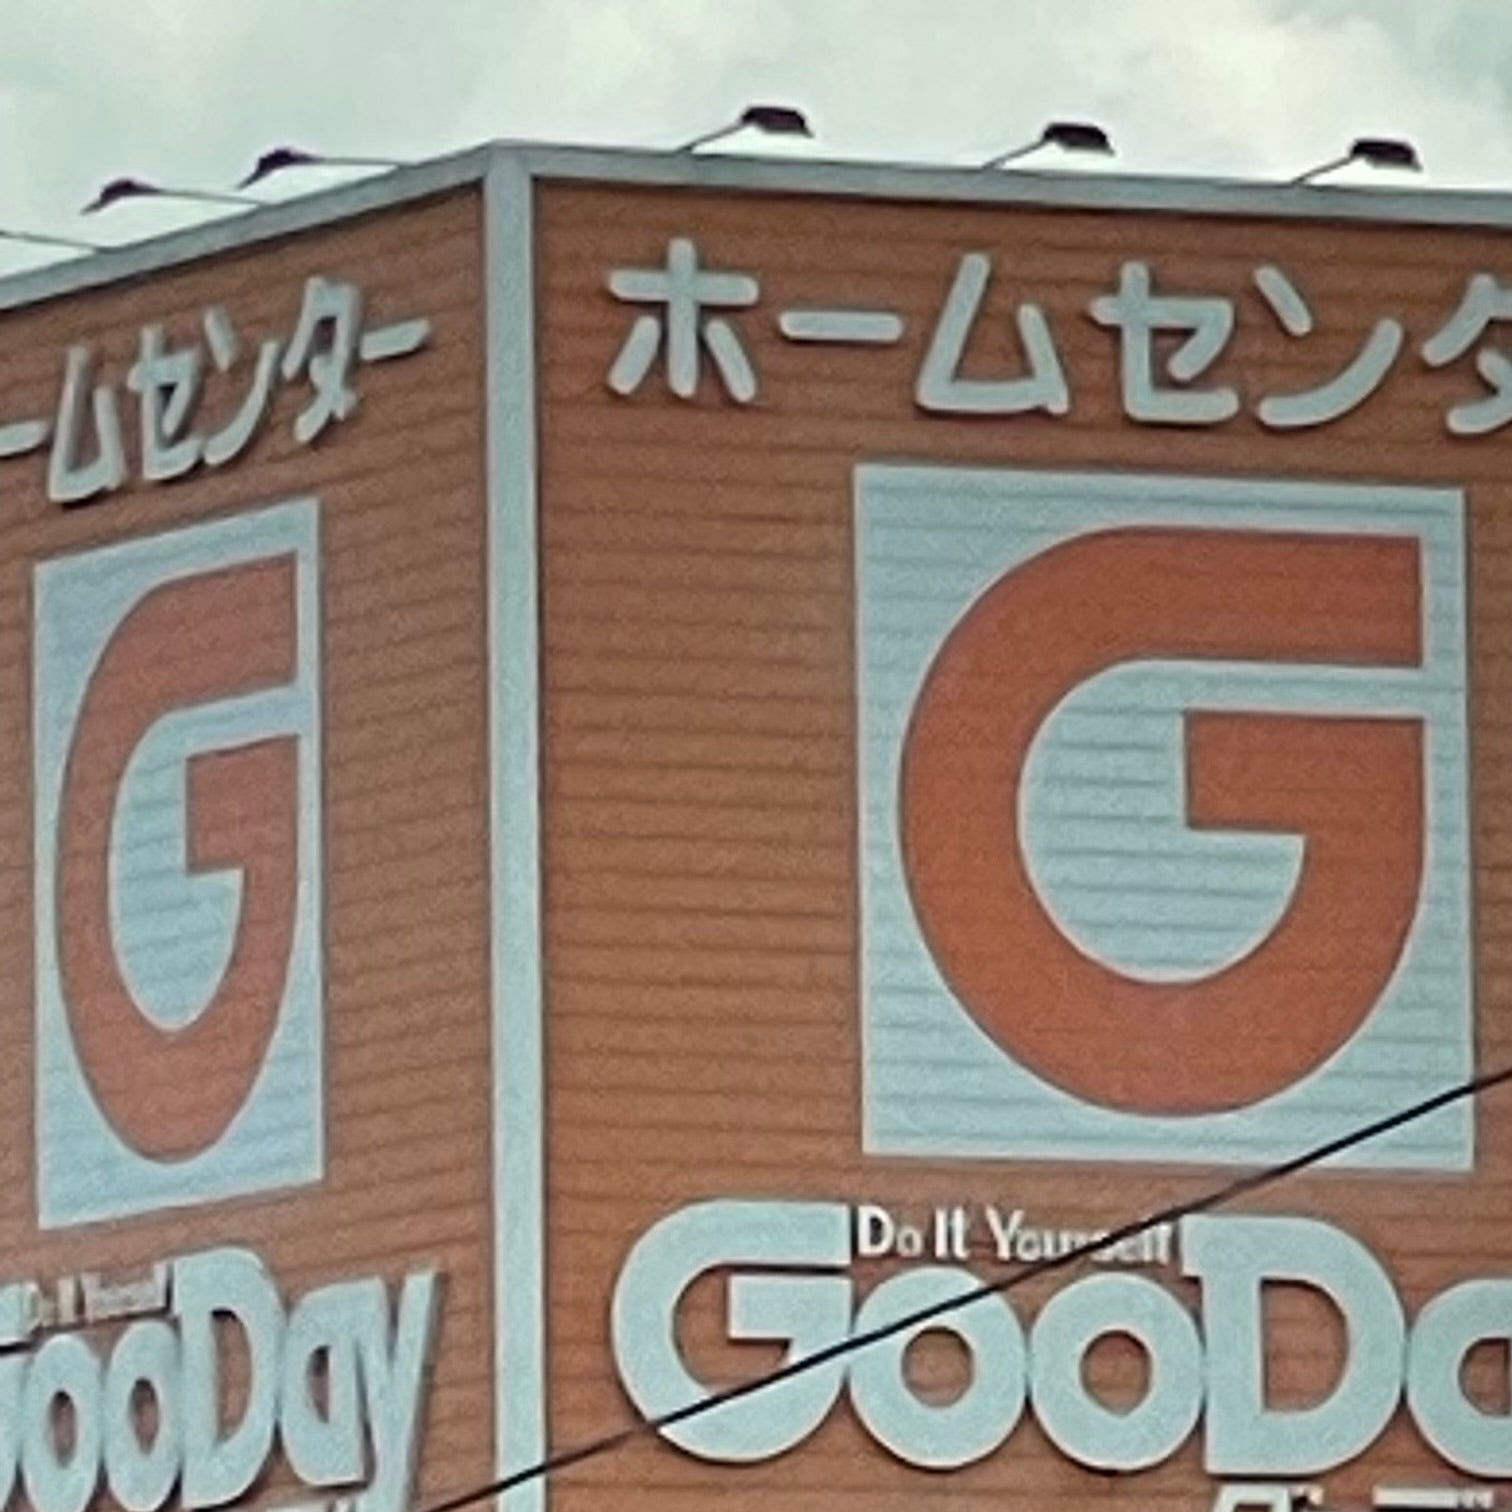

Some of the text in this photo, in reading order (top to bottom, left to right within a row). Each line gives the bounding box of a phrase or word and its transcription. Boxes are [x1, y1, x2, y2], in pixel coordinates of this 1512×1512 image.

[54, 548, 301, 1164] G
[898, 524, 1428, 1118] G
[857, 1204, 922, 1257] Do
[935, 1207, 970, 1259] It
